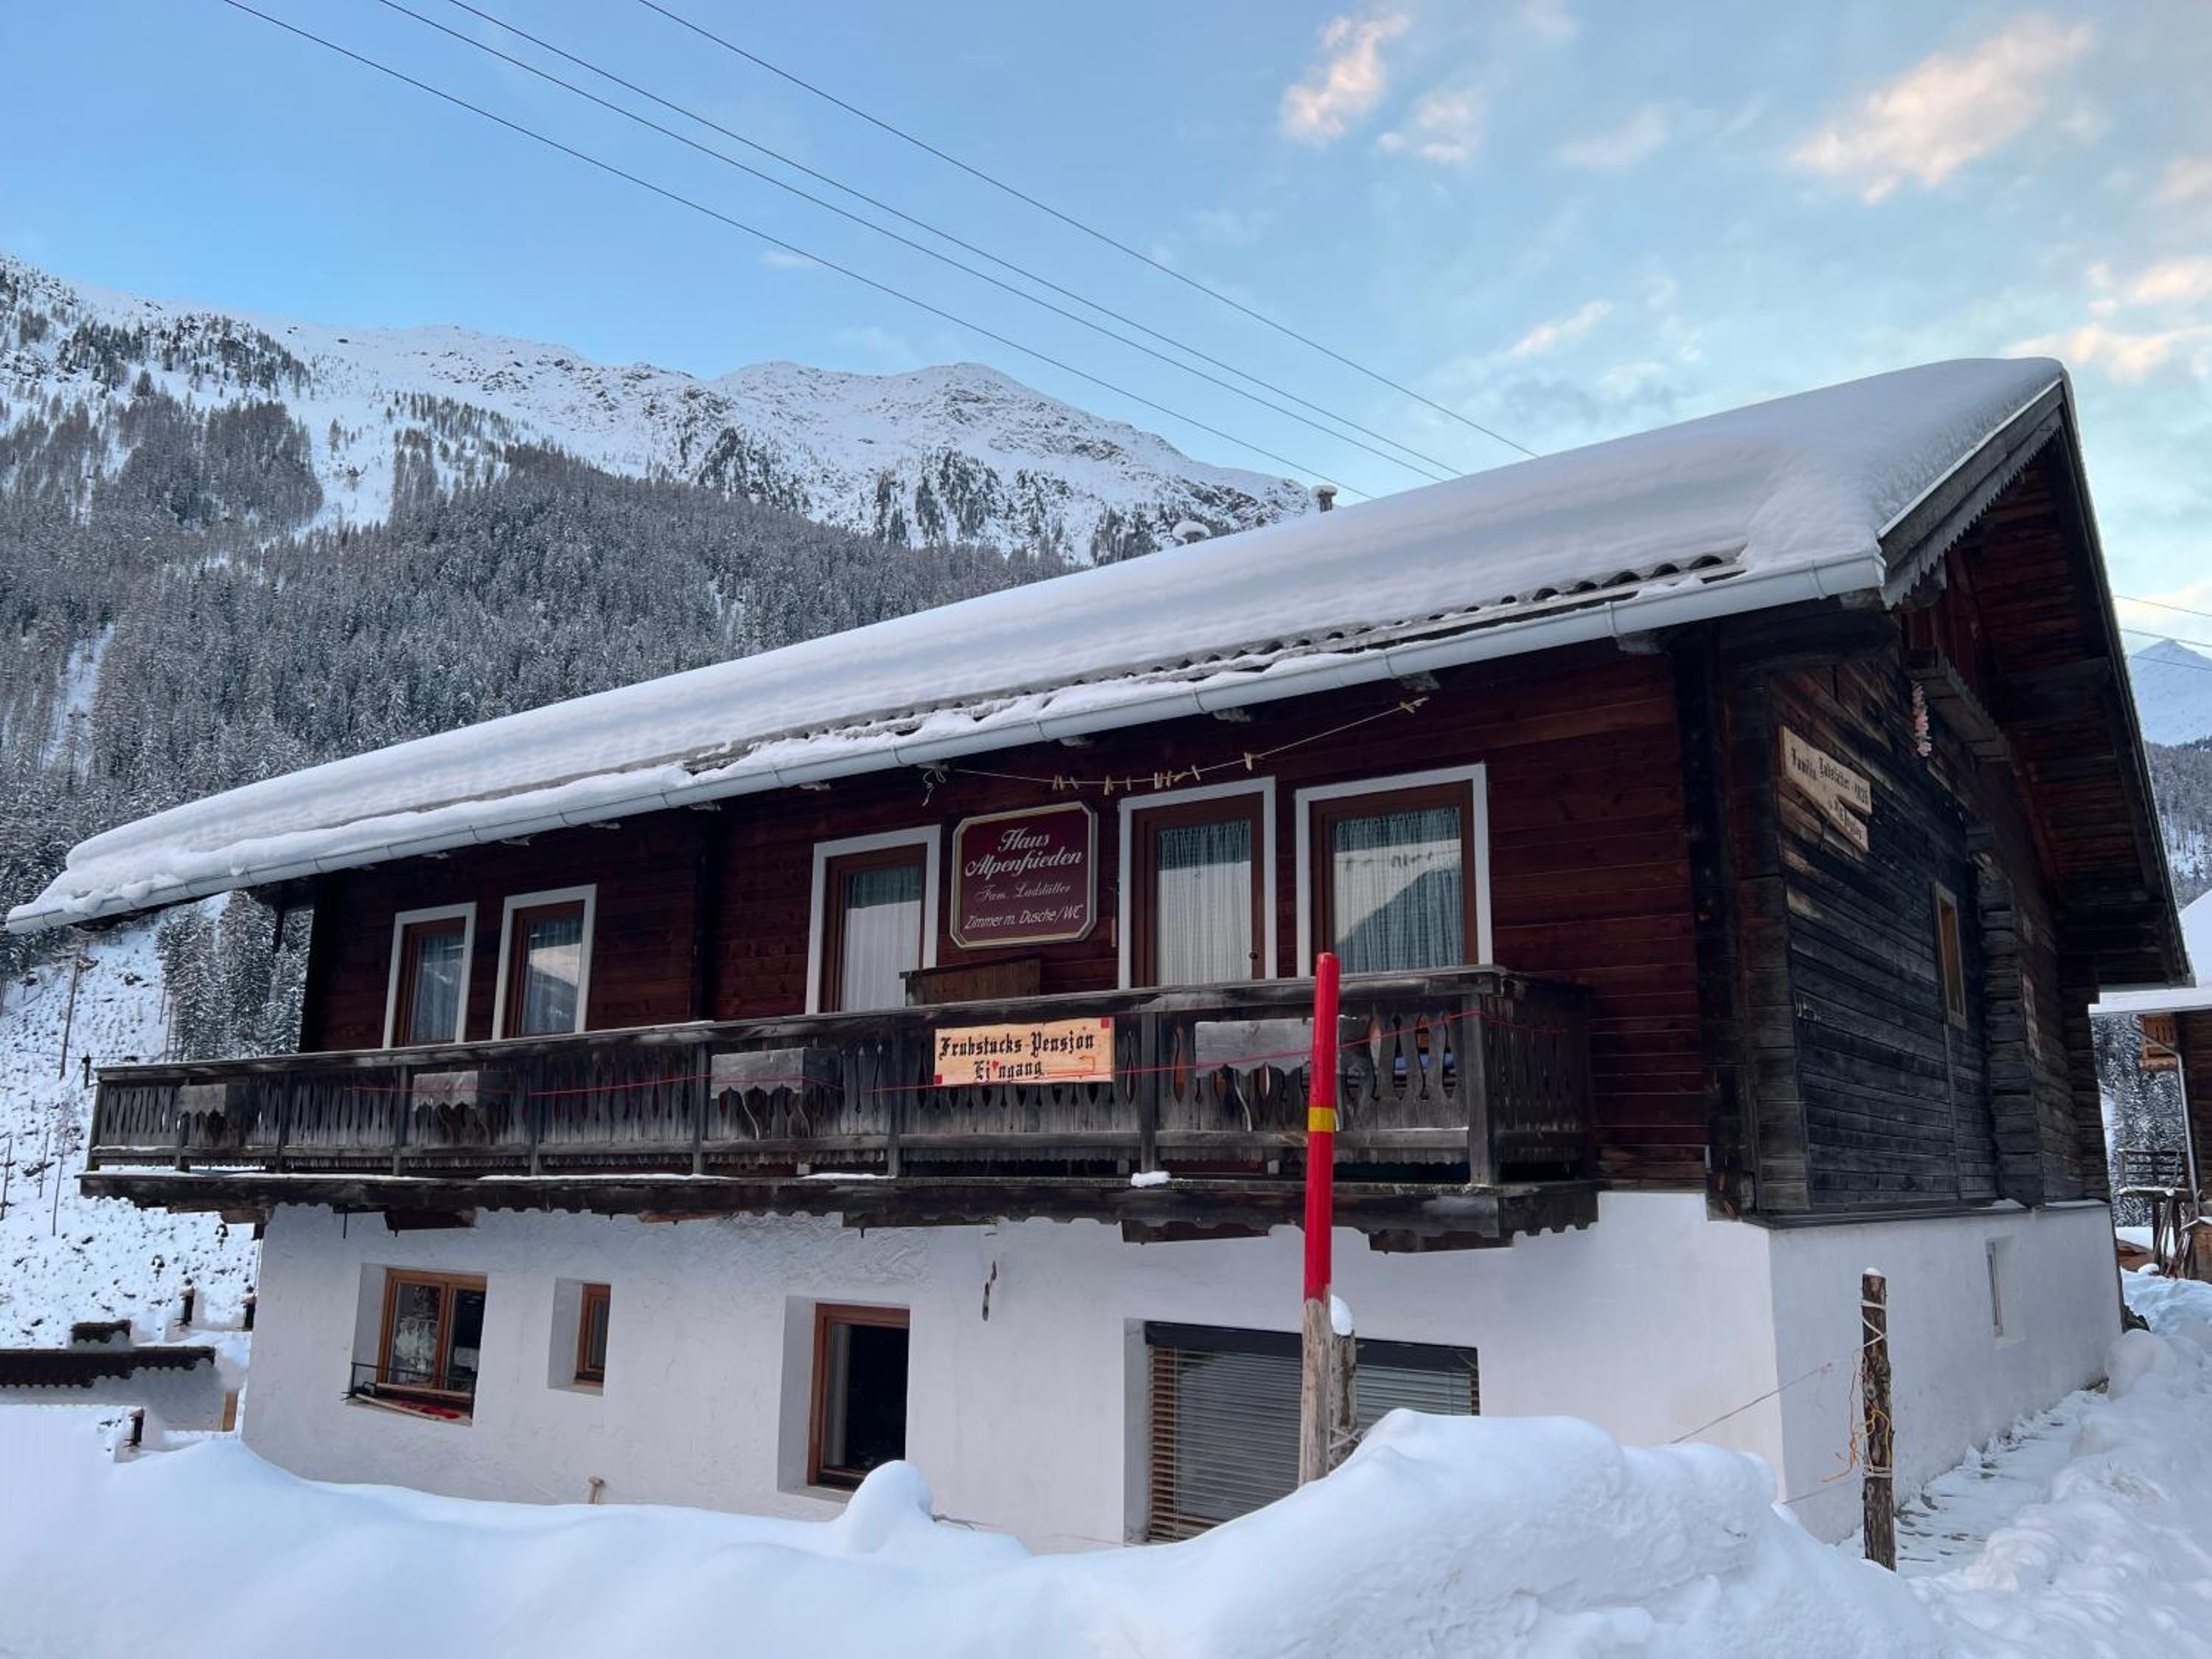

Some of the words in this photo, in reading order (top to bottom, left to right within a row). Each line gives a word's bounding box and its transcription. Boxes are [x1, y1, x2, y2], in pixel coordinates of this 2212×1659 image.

[998, 827, 1050, 852] Haus
[965, 846, 1083, 881] Alpenfrieden
[965, 914, 1004, 929] Zimmer
[1018, 904, 1084, 925] Dusche/WC
